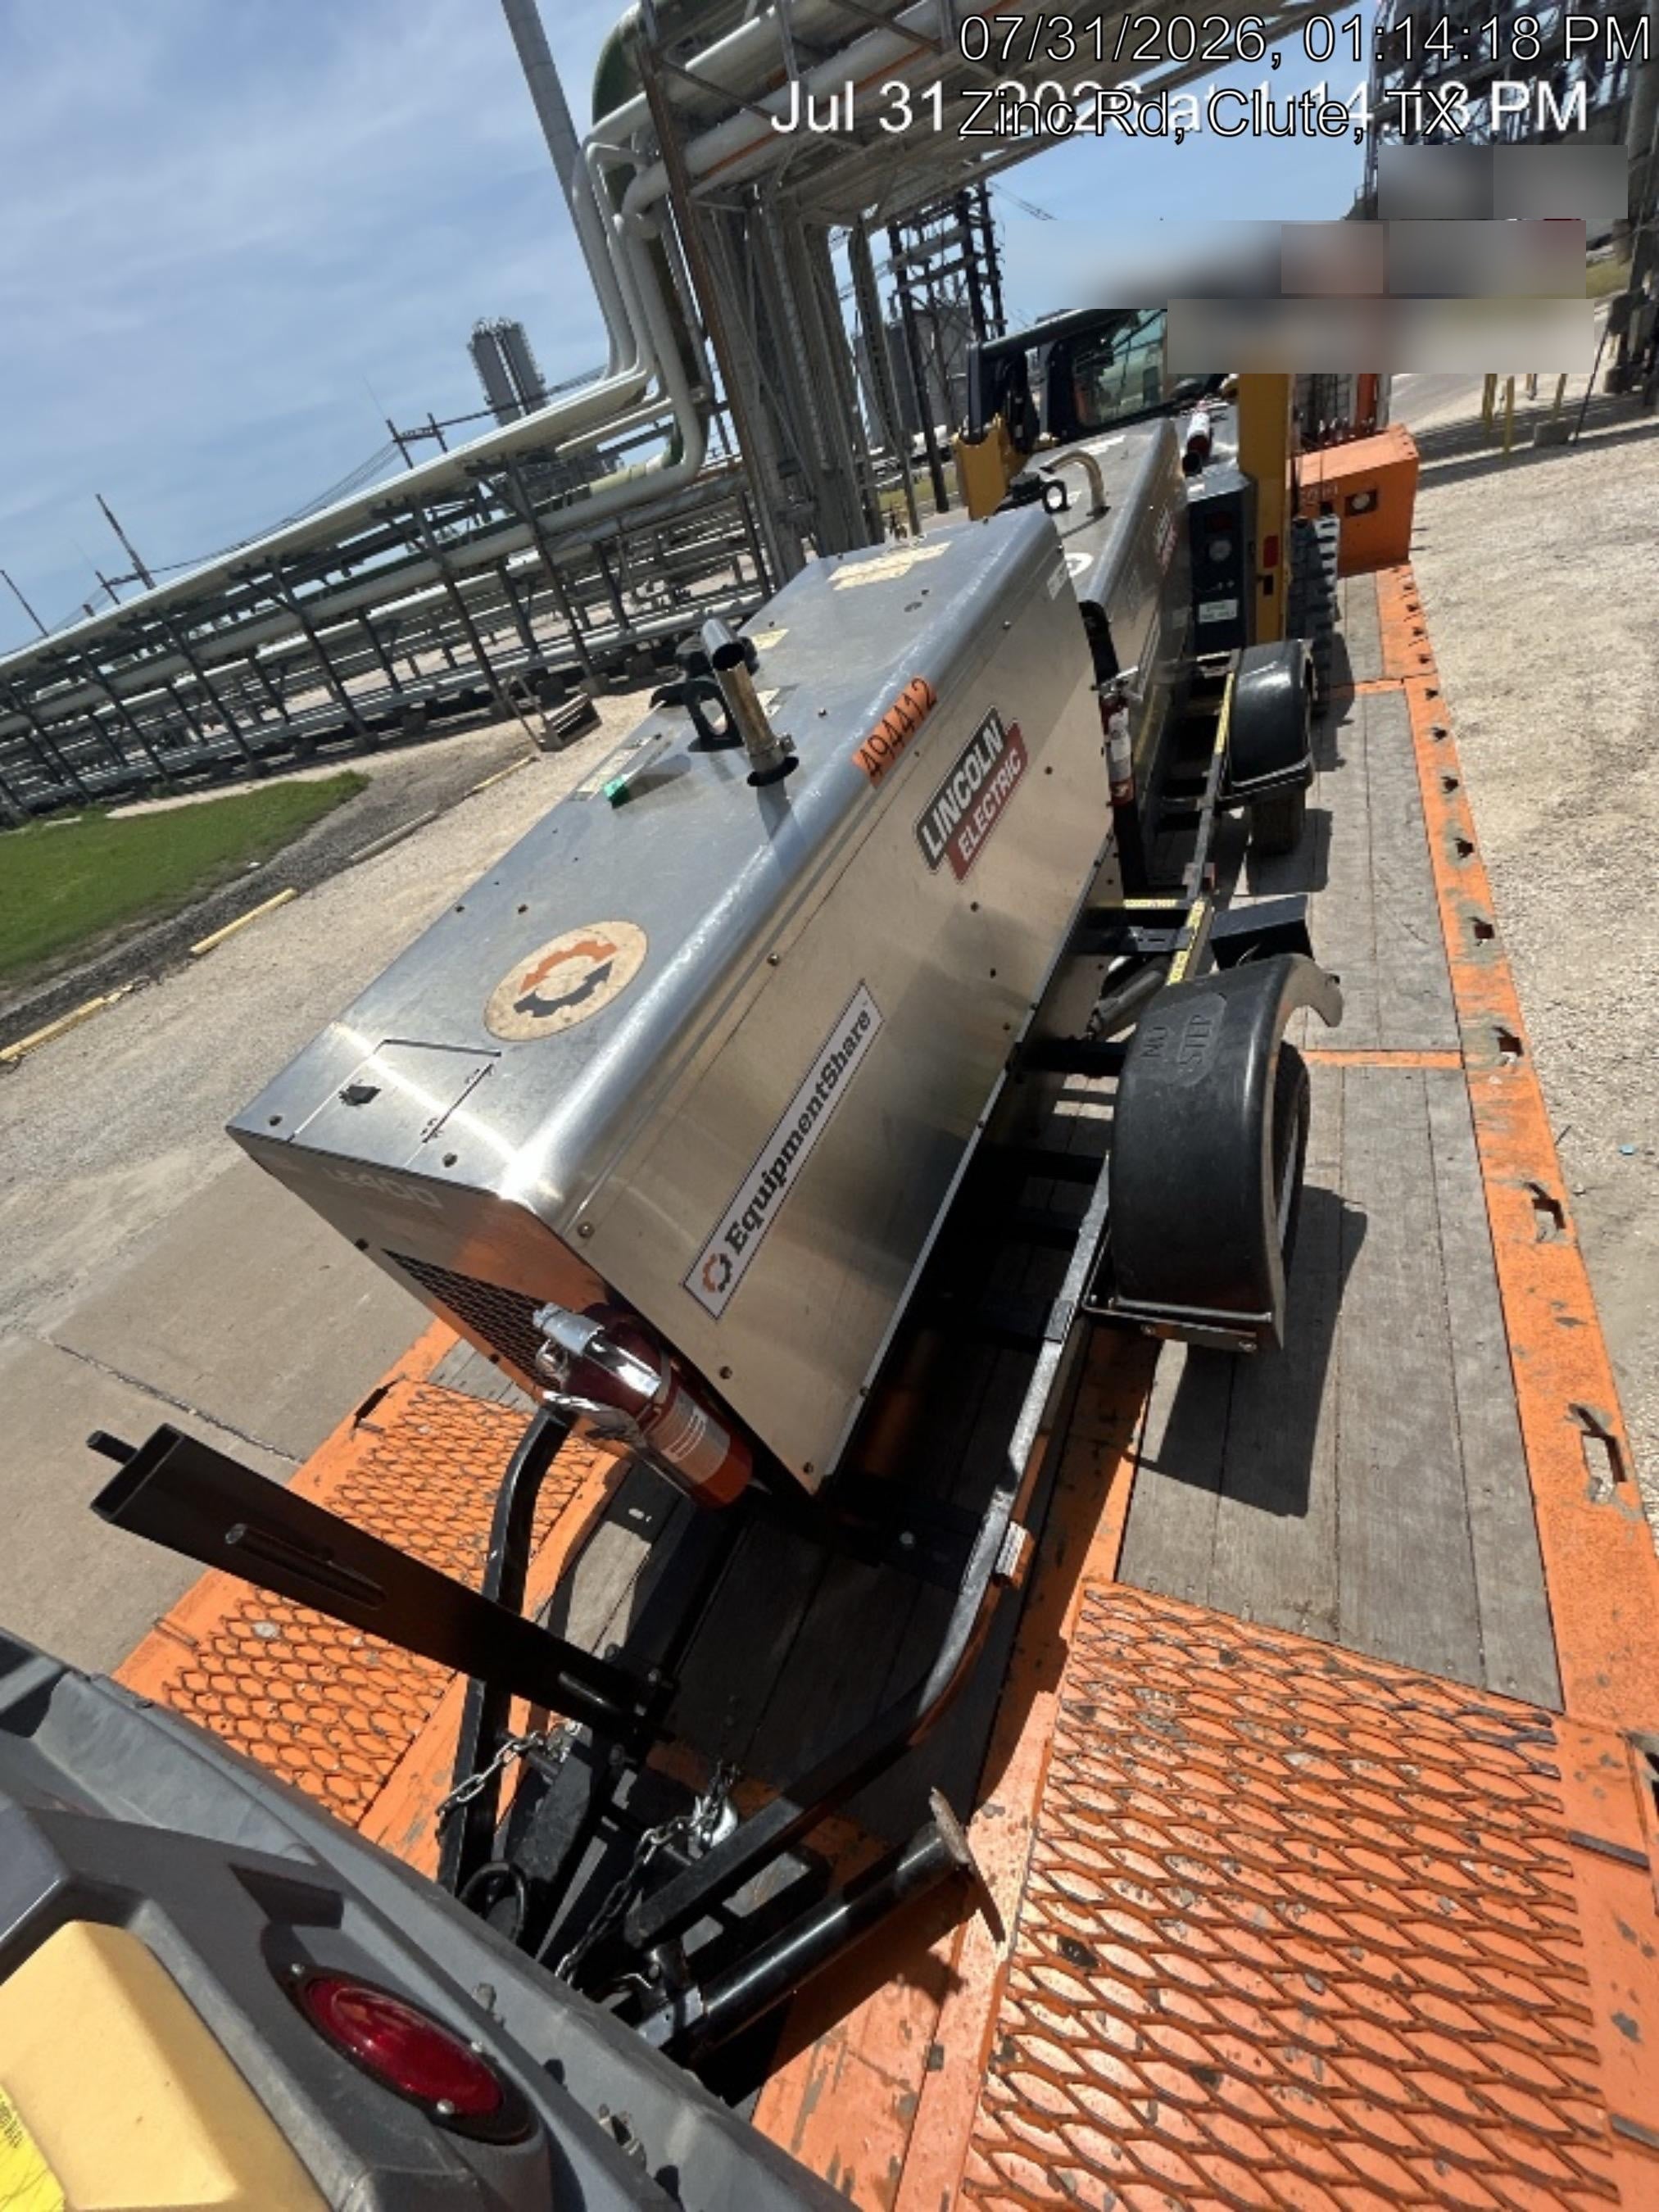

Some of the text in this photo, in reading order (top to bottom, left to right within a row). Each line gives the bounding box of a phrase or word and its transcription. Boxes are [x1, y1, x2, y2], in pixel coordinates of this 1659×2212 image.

[921, 718, 1004, 859] LINCOLN
[957, 748, 1022, 859] ELECTRIC
[1179, 1014, 1212, 1065] STEP
[724, 1008, 872, 1257] EquipmentShare
